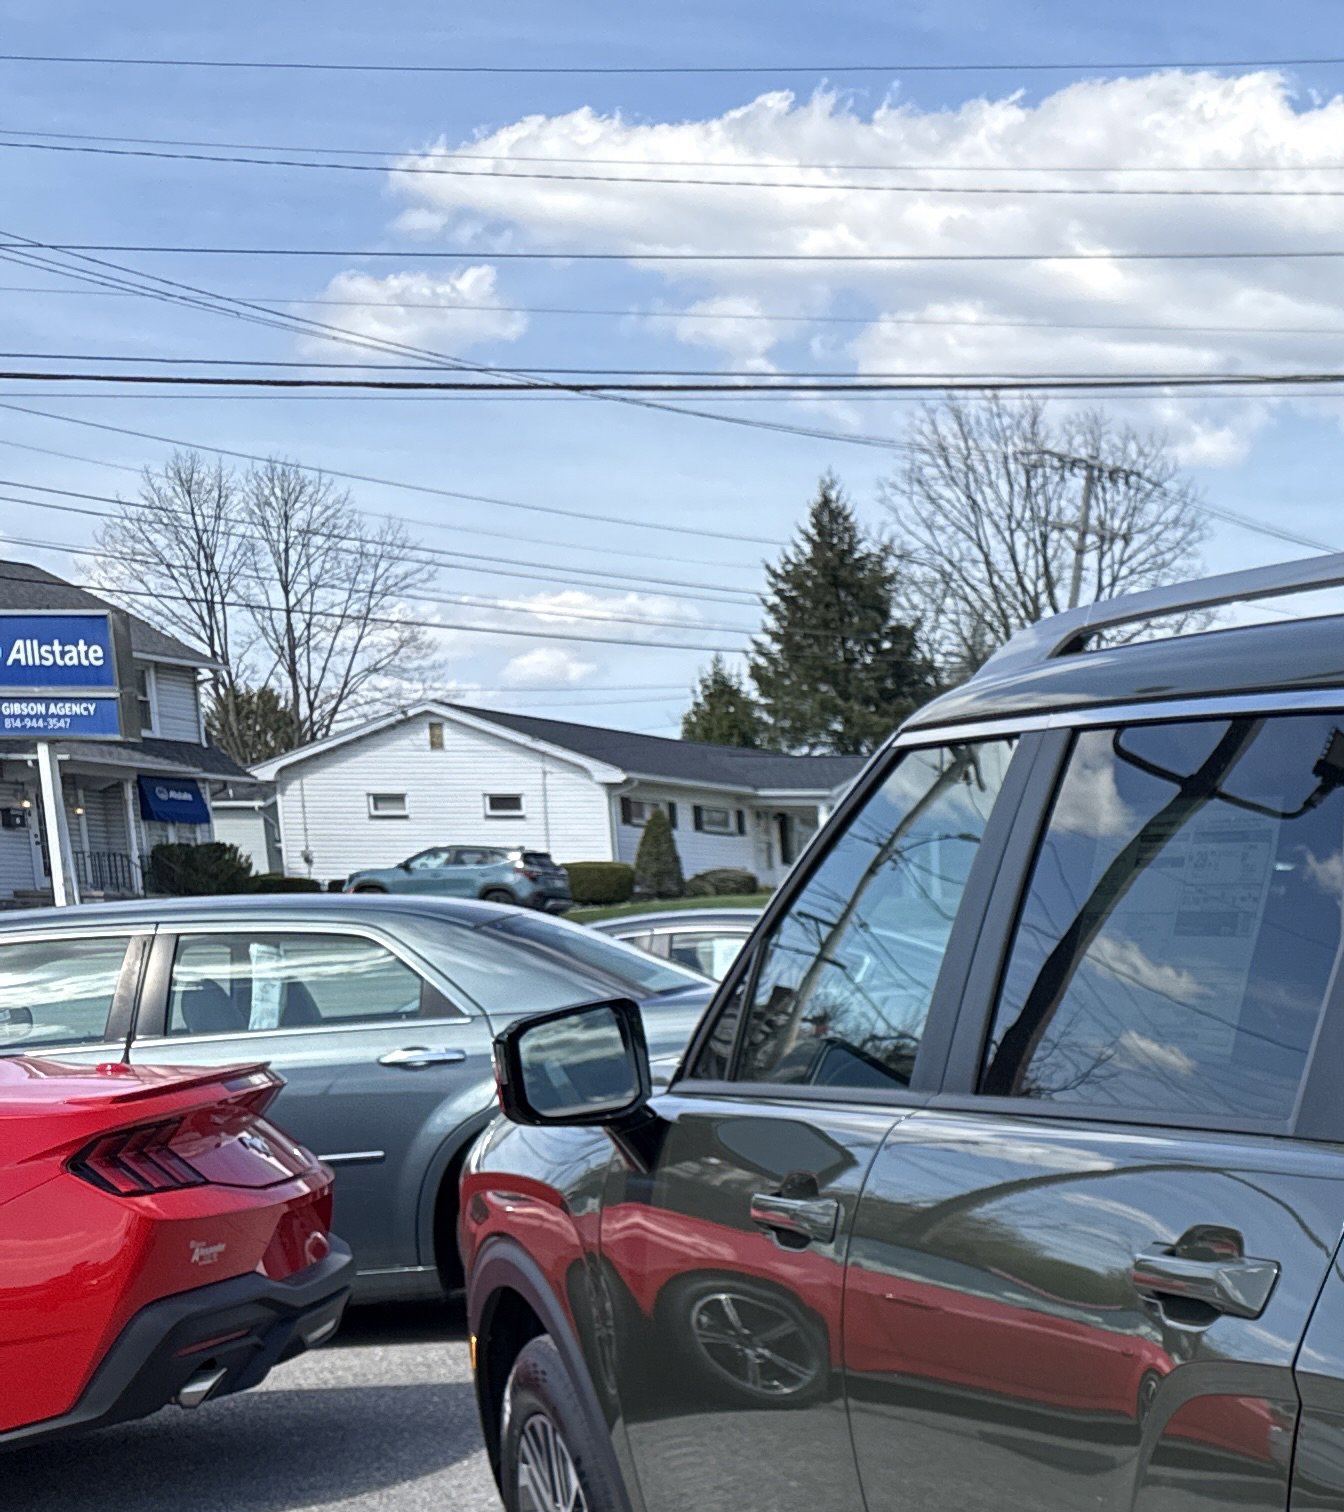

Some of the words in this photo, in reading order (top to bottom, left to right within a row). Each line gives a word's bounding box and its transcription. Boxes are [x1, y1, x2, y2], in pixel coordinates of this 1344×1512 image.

[6, 638, 105, 667] Allstate
[1, 702, 46, 716] GIBSON
[48, 702, 97, 716] AGENCY
[4, 717, 71, 730] 814-944-3547
